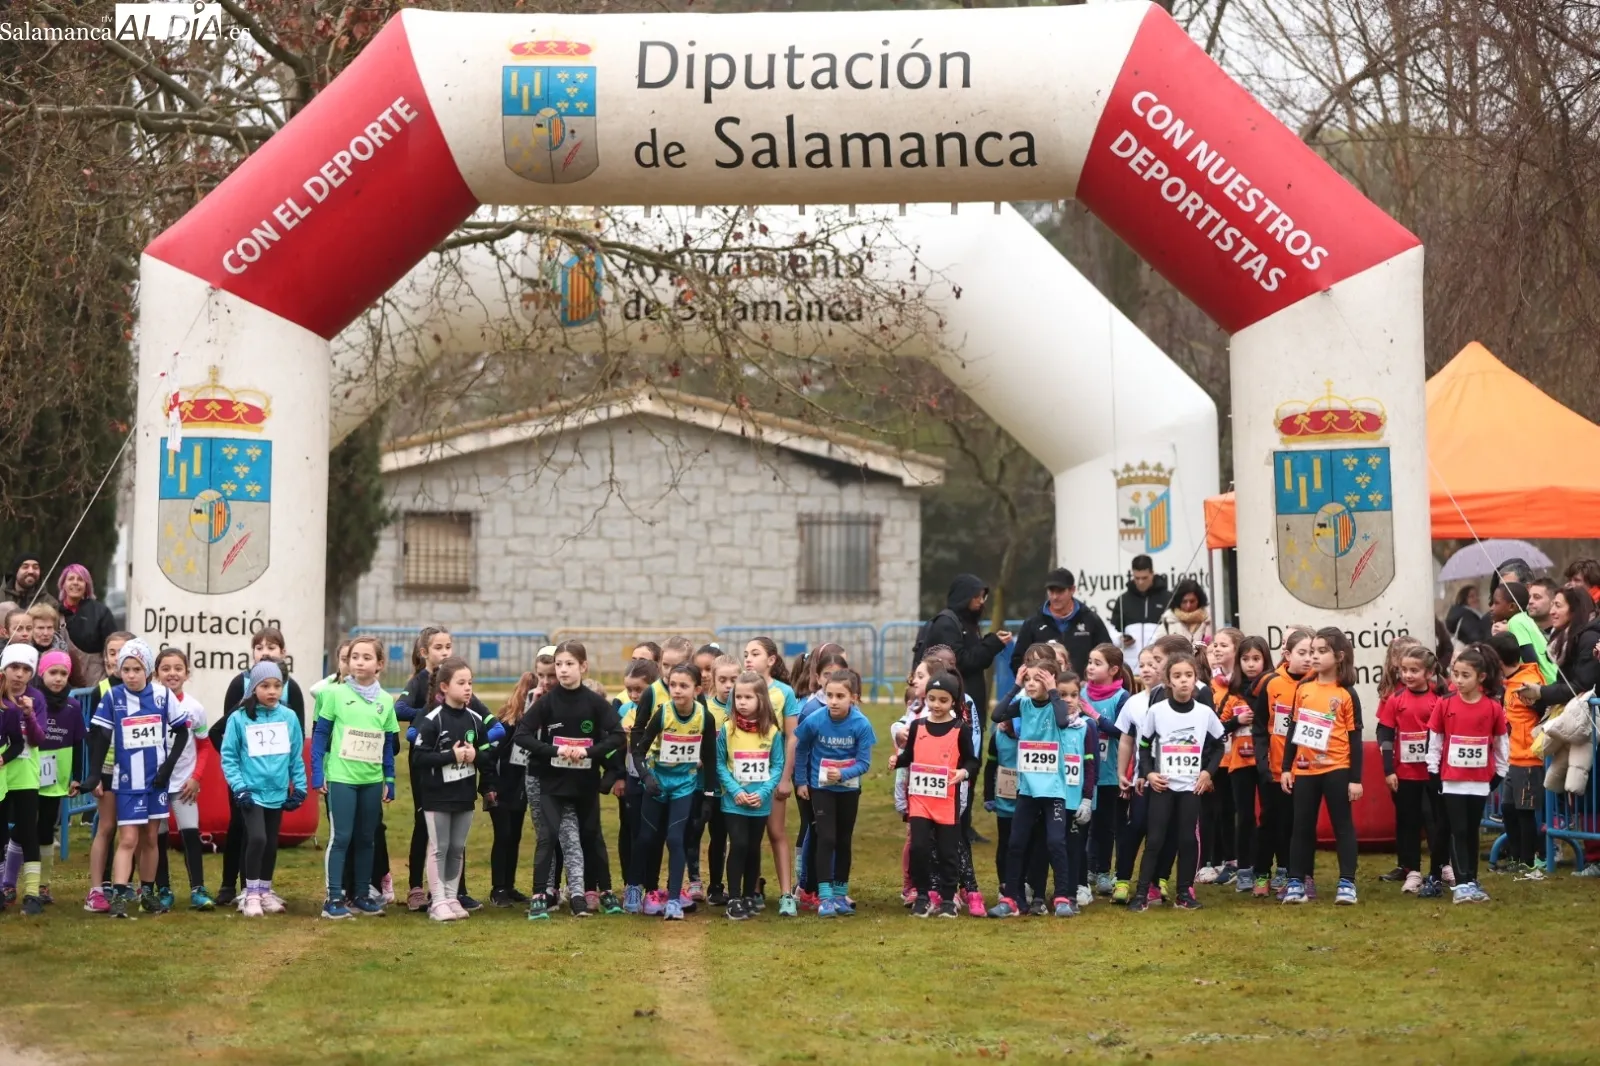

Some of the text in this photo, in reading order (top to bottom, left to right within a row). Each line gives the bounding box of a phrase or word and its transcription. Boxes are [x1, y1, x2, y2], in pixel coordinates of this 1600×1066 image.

[636, 38, 971, 104] Diputación
[634, 113, 1038, 169] de Salamanca
[222, 95, 419, 275] CON EL DEPORTE
[1131, 90, 1329, 270] CON NUESTROS
[1109, 129, 1287, 292] DEPORTISTAS
[132, 726, 156, 739] 541
[255, 728, 281, 747] 72
[1301, 725, 1323, 740] 265
[669, 744, 695, 755] 215
[1457, 747, 1482, 759] 535
[1023, 752, 1057, 764] 1299
[1166, 755, 1199, 767] 1192
[741, 762, 765, 773] 213
[914, 775, 946, 789] 1135
